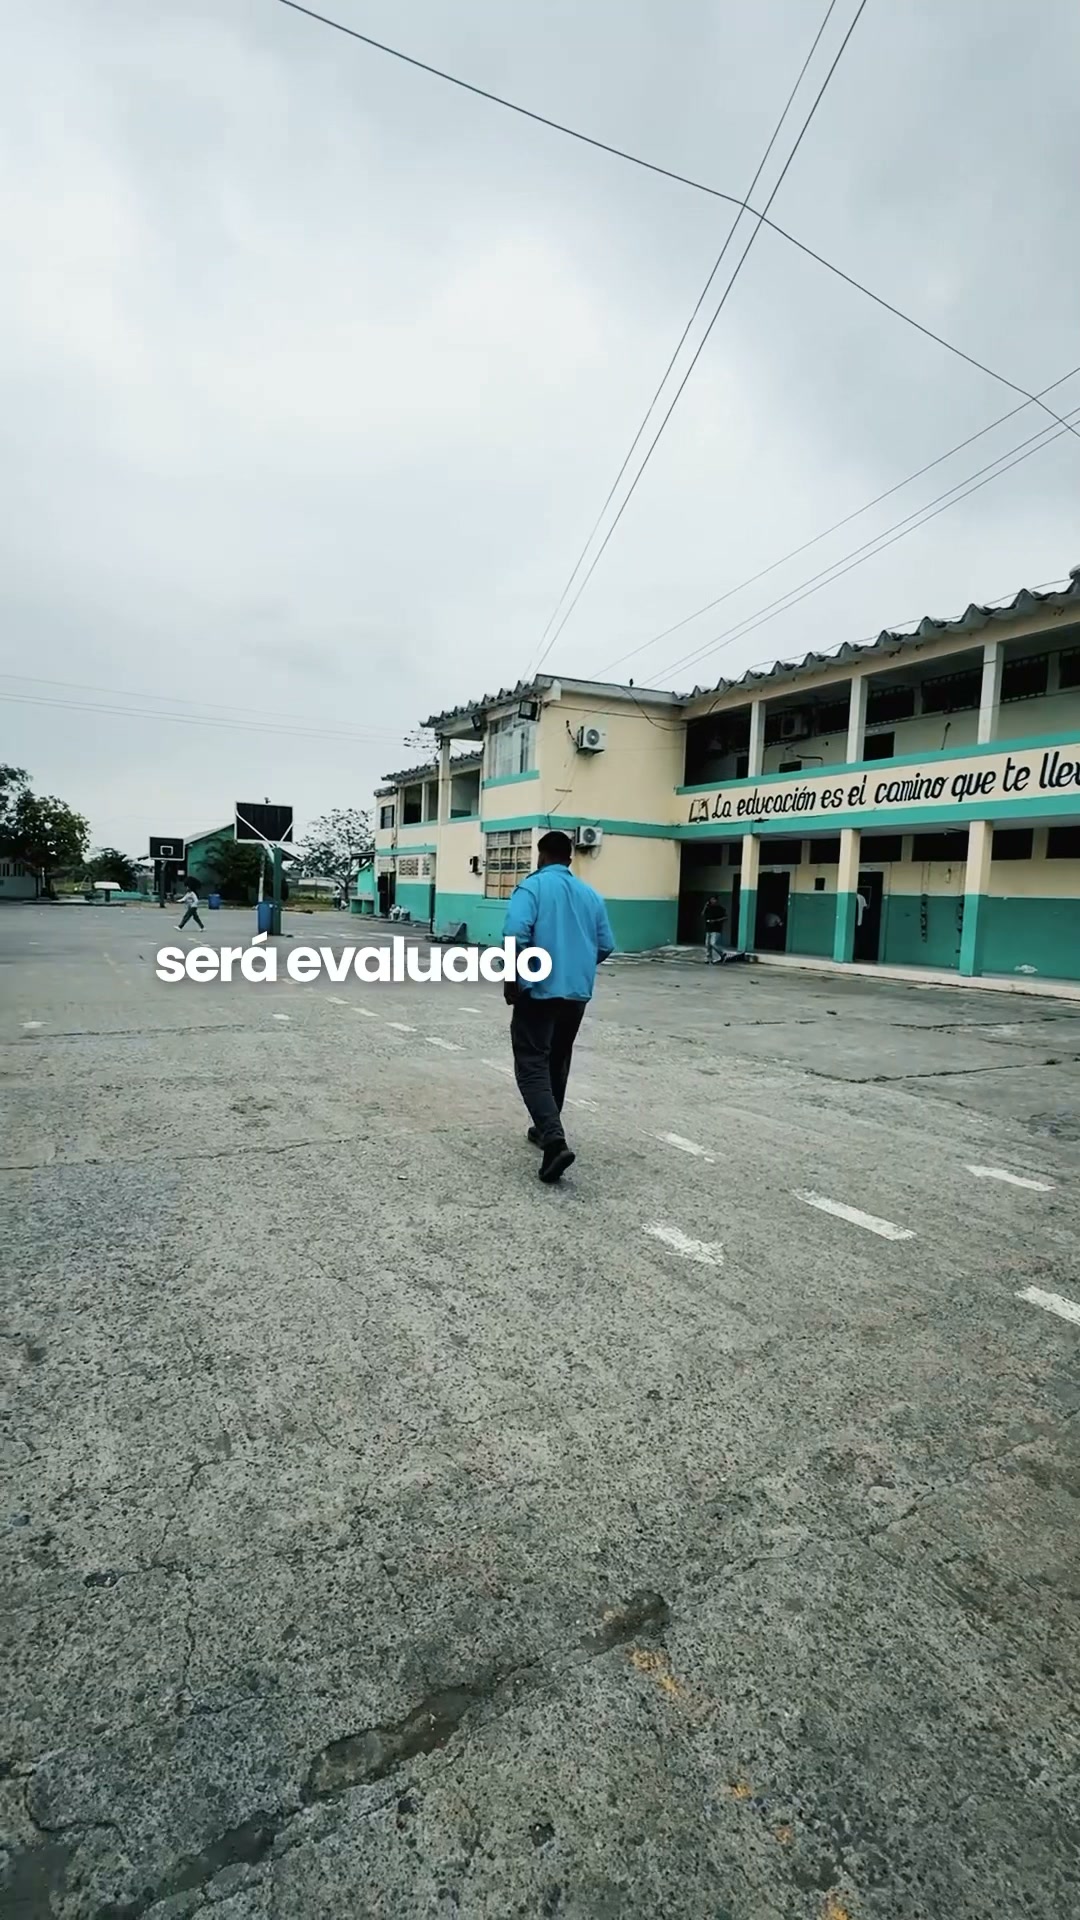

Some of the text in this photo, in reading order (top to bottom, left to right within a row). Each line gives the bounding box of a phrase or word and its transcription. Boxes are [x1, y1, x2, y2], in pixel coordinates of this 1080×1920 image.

[712, 793, 732, 819] La
[736, 785, 817, 817] educación
[820, 788, 844, 809] es
[847, 774, 868, 807] el
[874, 772, 949, 804] camino
[950, 770, 997, 804] que
[1002, 757, 1031, 793] te
